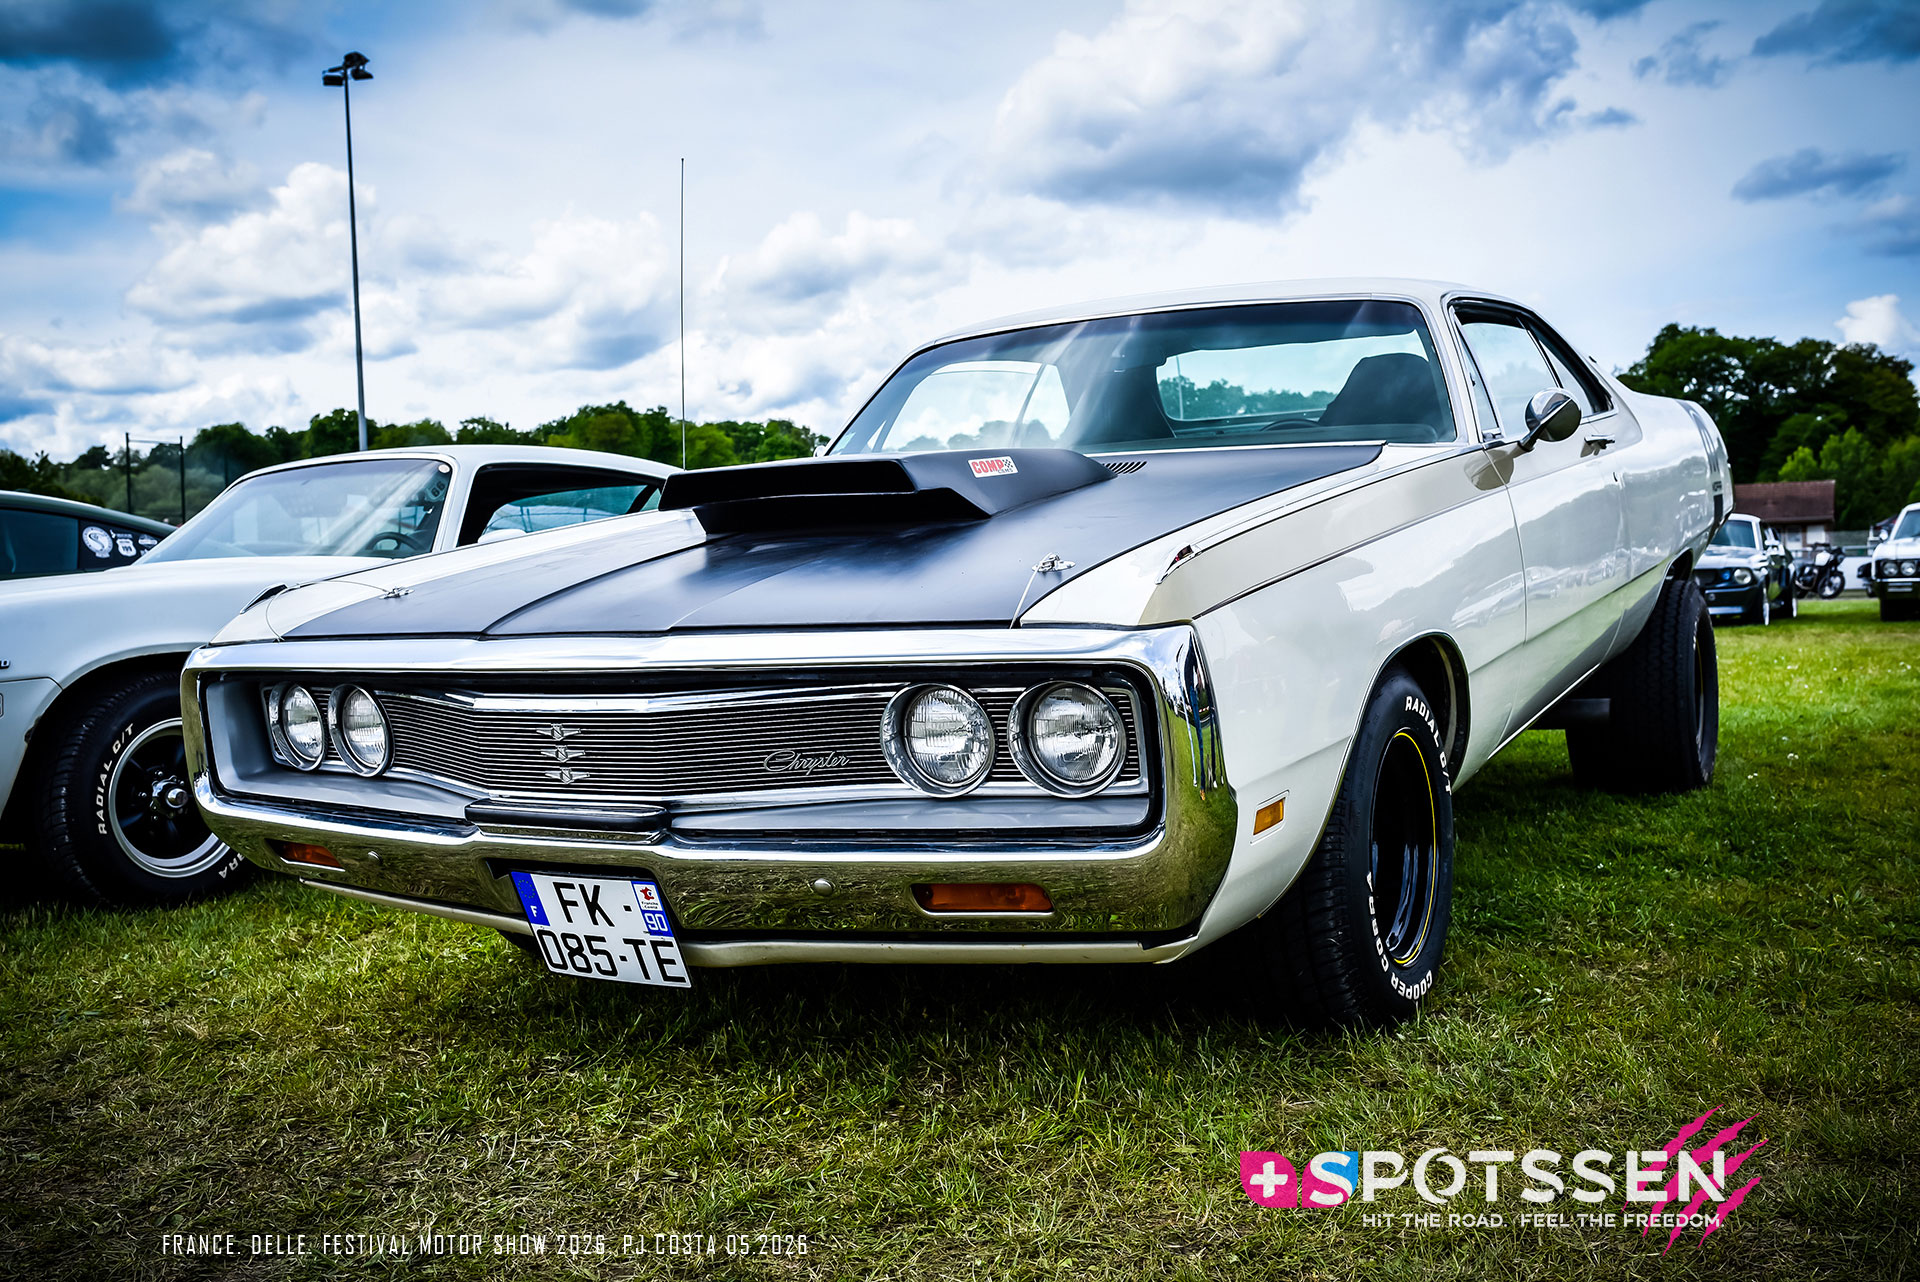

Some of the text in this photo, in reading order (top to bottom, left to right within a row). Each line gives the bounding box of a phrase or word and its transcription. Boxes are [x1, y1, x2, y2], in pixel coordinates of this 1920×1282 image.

[971, 459, 1004, 474] COMP
[1405, 695, 1440, 748] RADIAL
[763, 749, 850, 776] Chrysler
[95, 722, 134, 835] RADIAL G/T
[530, 905, 538, 918] F
[644, 913, 669, 932] 90
[536, 929, 687, 983] 085-TE
[1390, 969, 1433, 1001] COOPER
